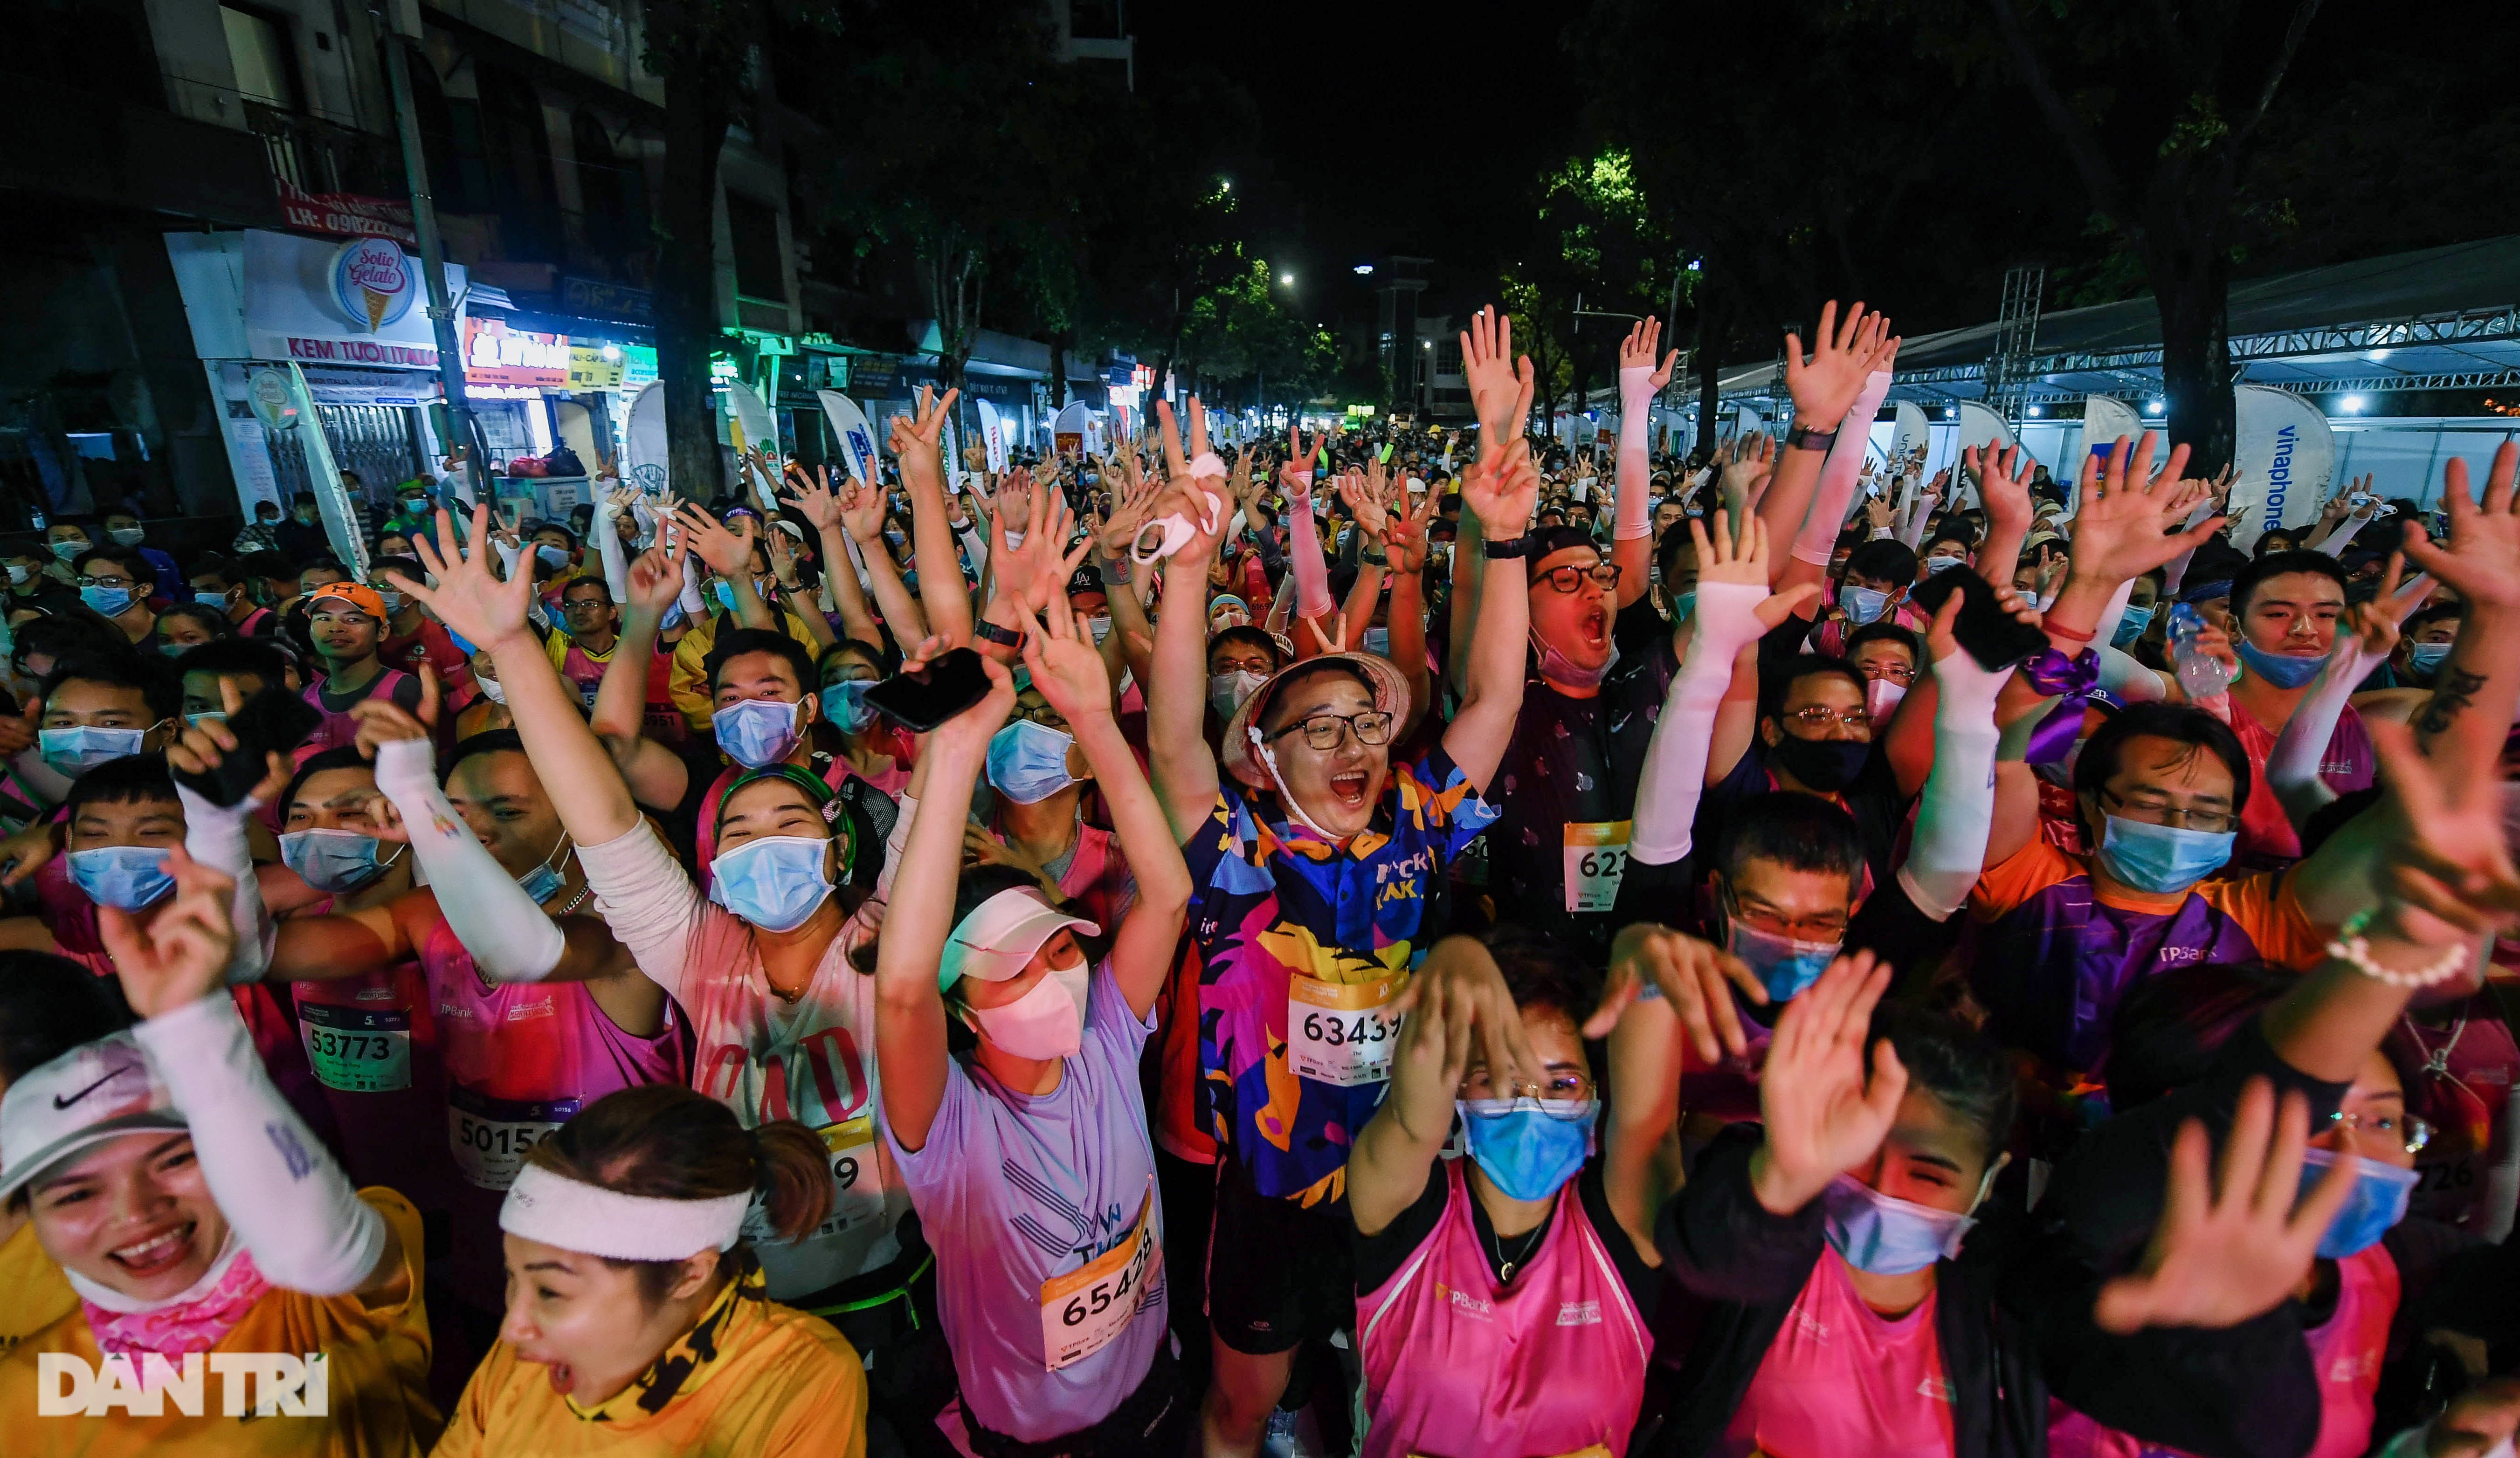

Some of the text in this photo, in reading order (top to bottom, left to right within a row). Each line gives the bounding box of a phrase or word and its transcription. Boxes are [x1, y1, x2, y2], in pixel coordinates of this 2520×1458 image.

[349, 263, 397, 286] Gelato
[287, 337, 335, 359] KEM
[2263, 425, 2296, 531] vinaphone
[441, 1004, 473, 1018] TPBank
[312, 1028, 390, 1060] 53773
[1062, 1228, 1153, 1327] 65428
